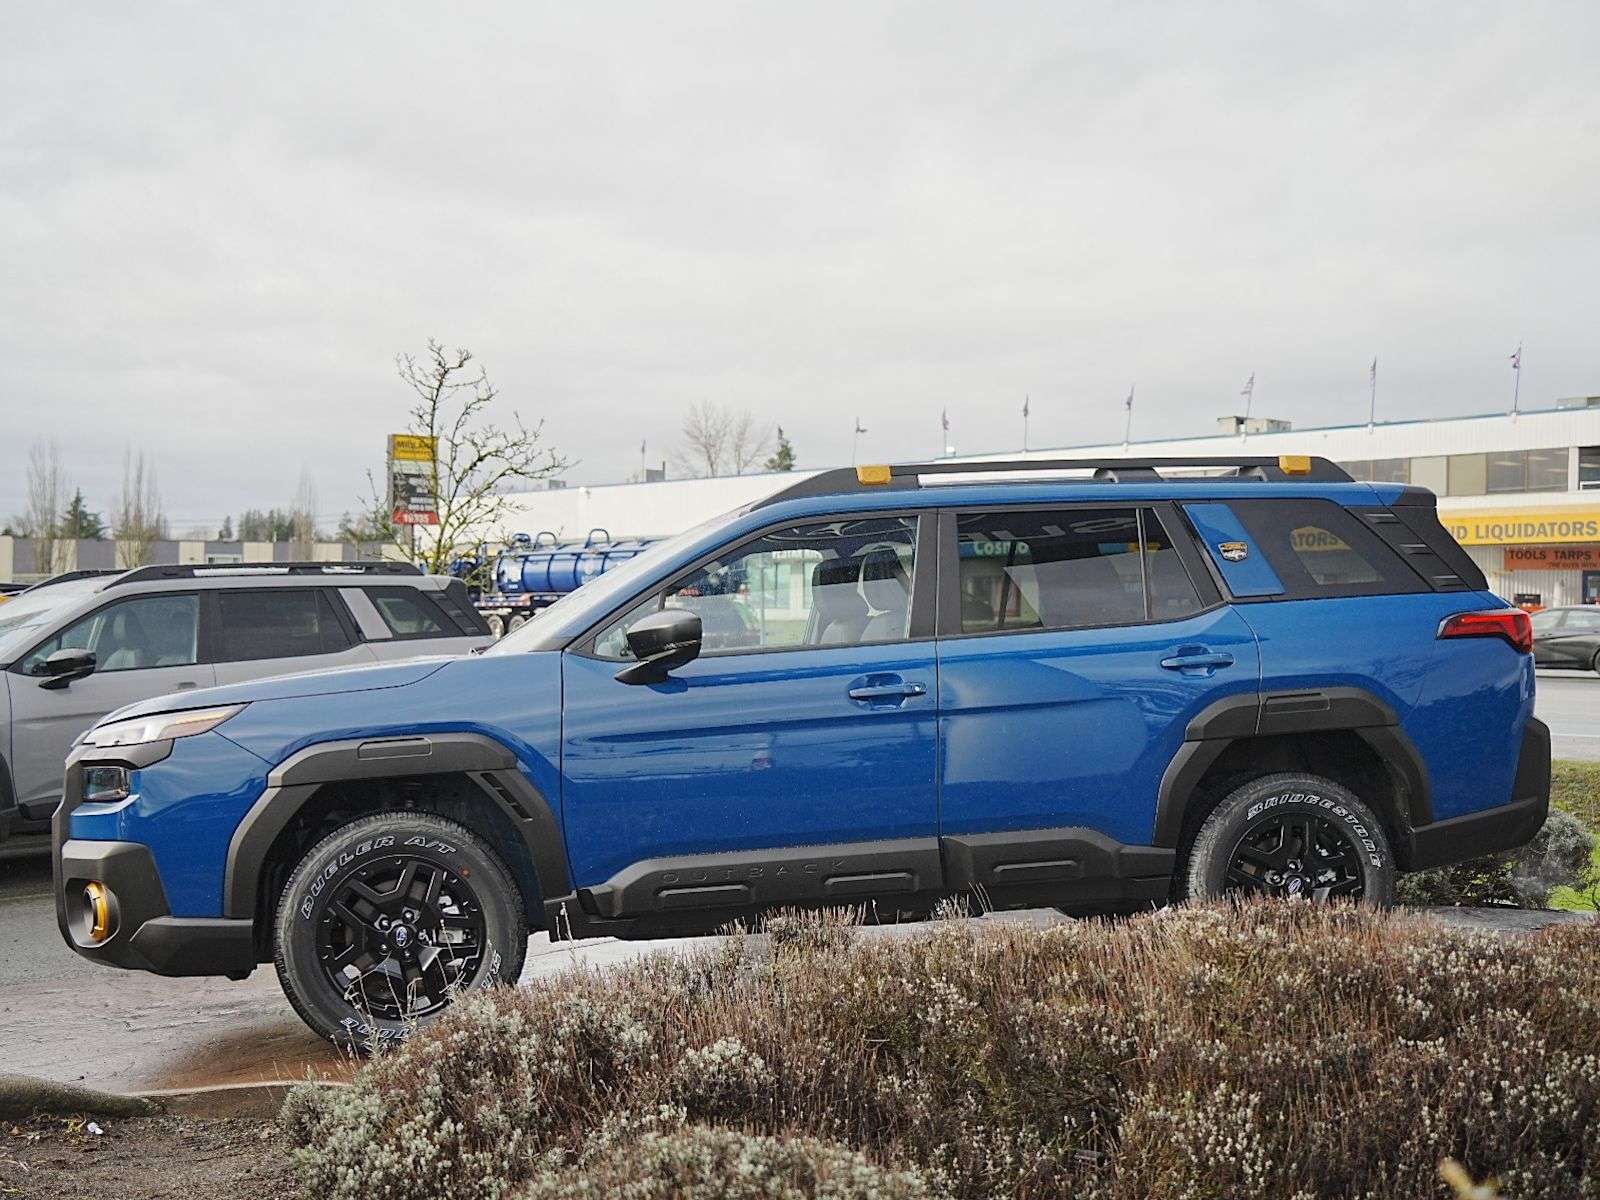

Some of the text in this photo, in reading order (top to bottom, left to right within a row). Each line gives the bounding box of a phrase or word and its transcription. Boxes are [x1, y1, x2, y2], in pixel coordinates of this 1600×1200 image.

[1291, 532, 1338, 548] TORS
[1475, 520, 1598, 541] LIQUIDATORS
[1509, 550, 1546, 560] TOOLS
[1554, 549, 1592, 560] TARPS
[1246, 793, 1382, 869] BRIDGESTONE
[300, 835, 457, 920] DUELER A/T
[662, 859, 845, 884] OUTBACK
